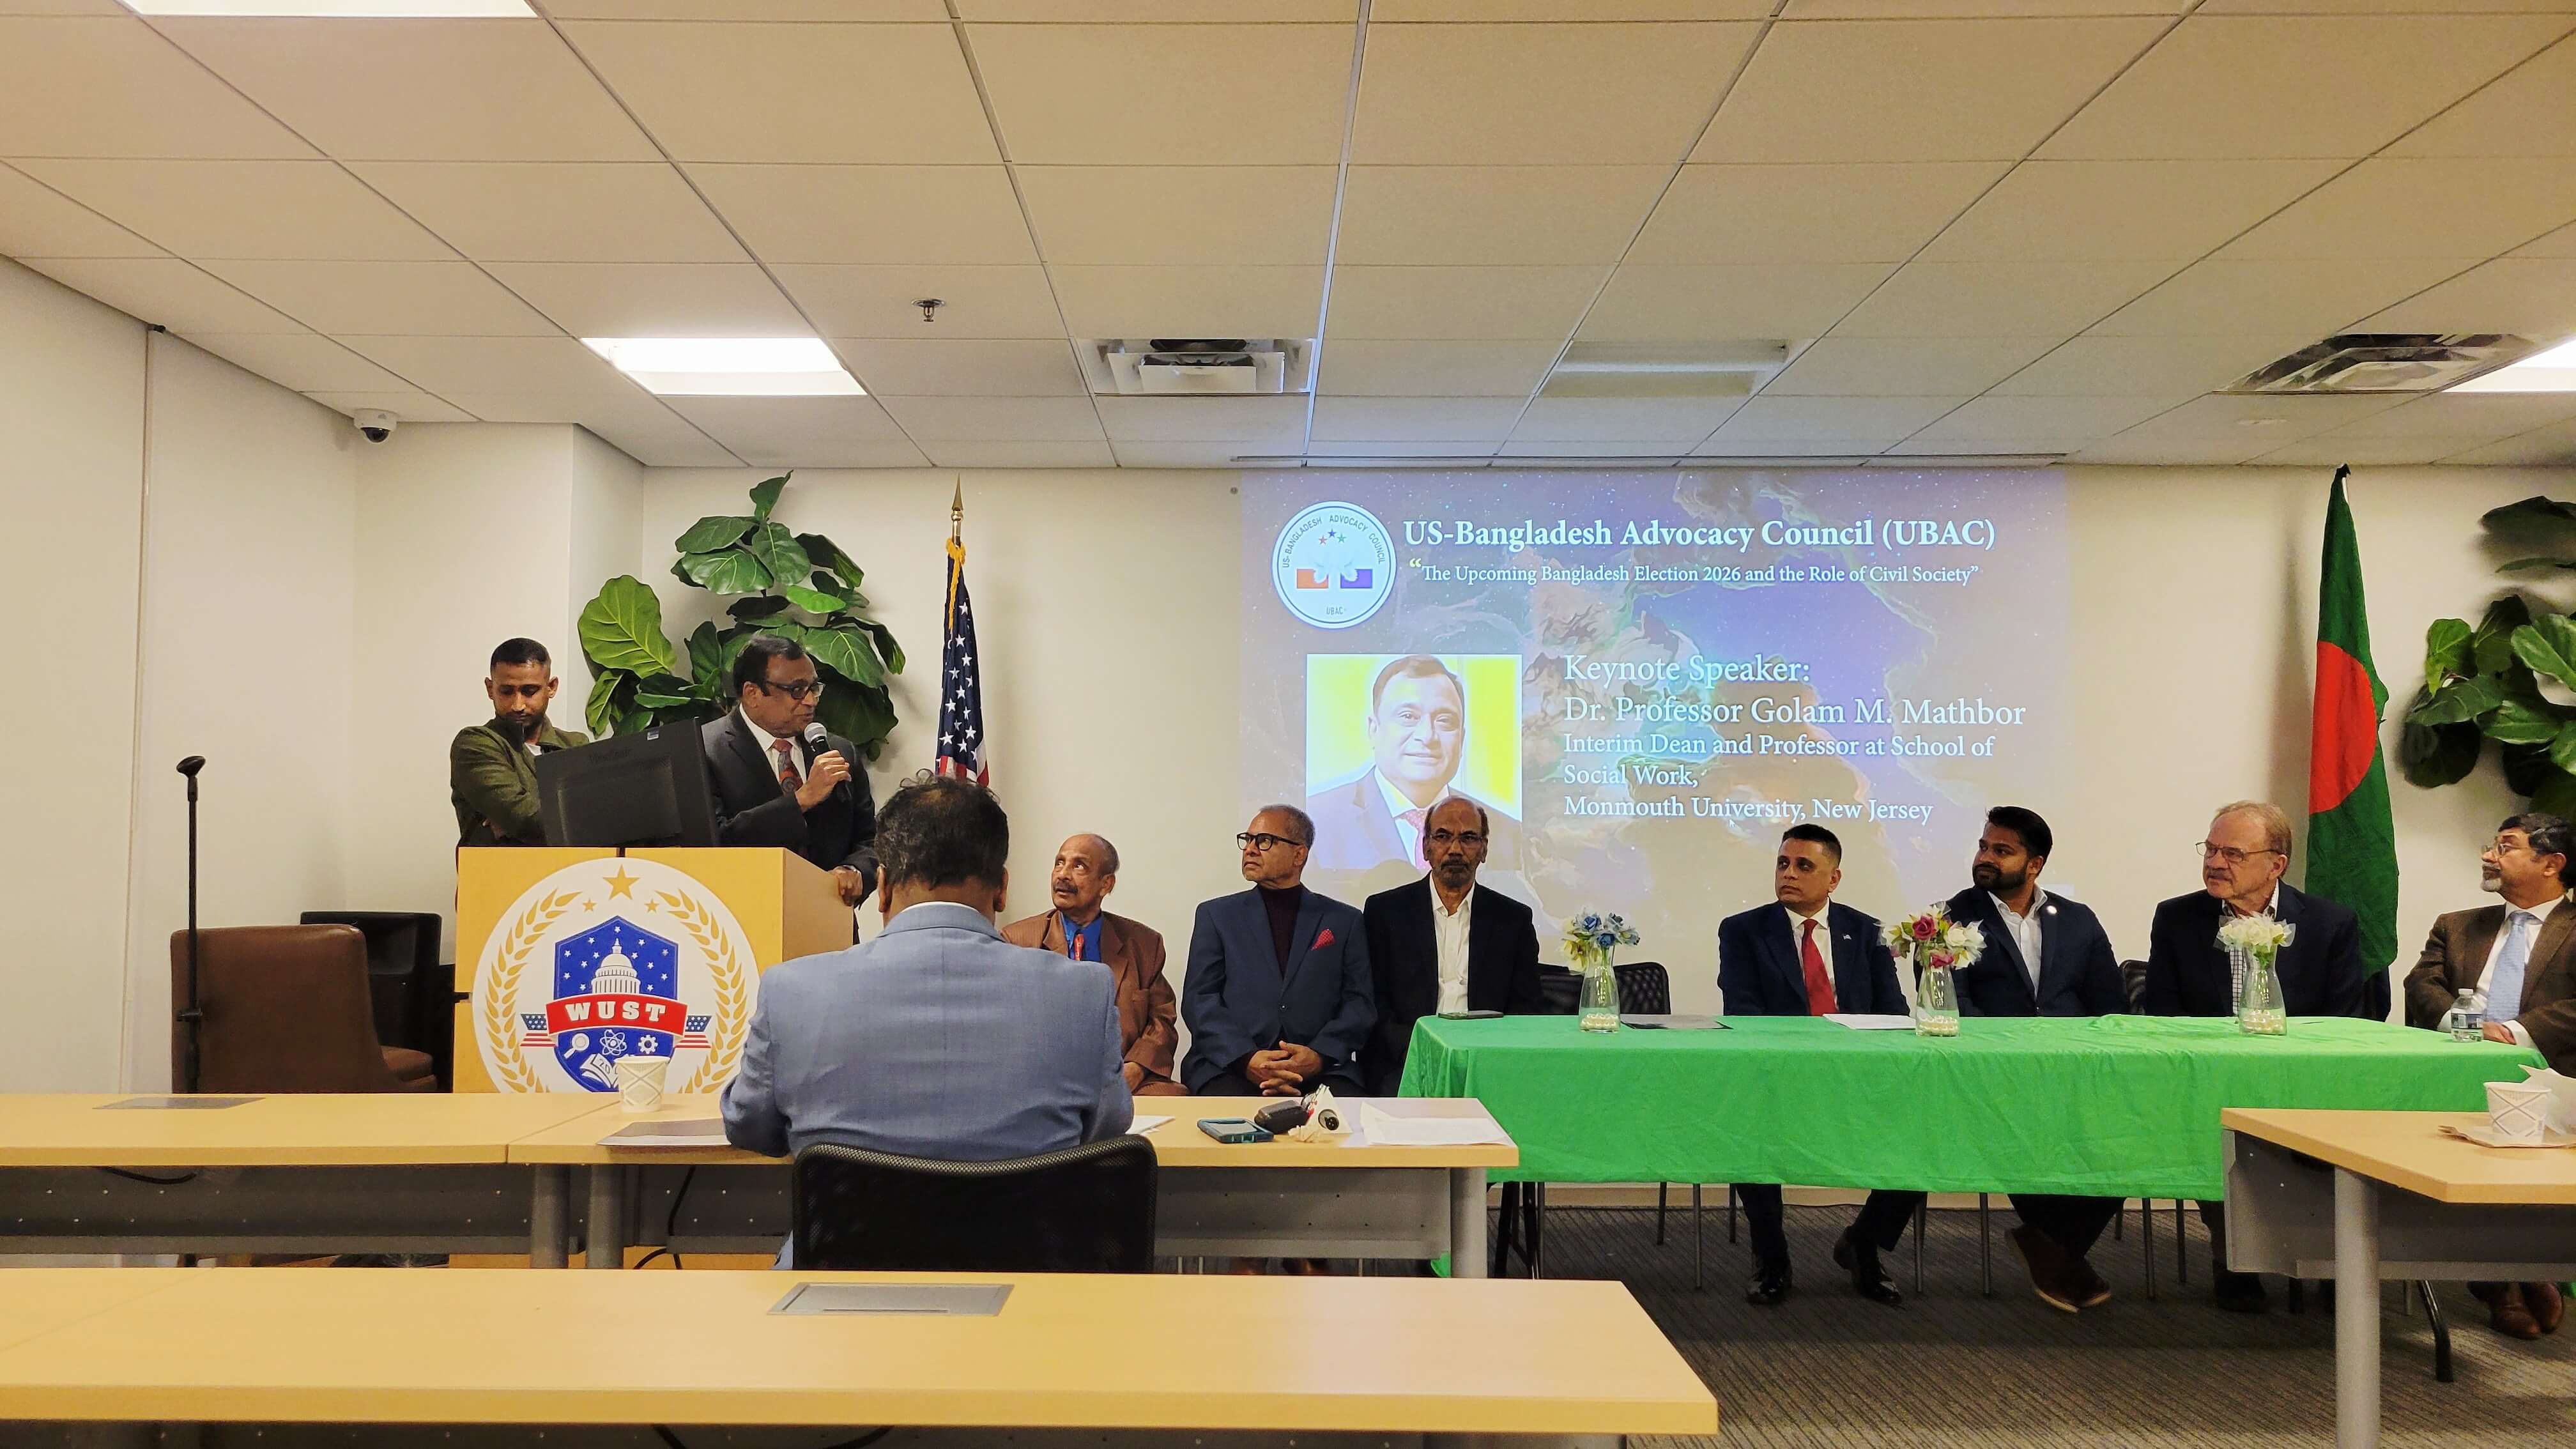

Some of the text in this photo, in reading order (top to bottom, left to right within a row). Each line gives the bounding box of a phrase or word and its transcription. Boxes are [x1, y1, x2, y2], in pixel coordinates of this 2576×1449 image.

[1330, 514, 1369, 532] ADVOCACY
[1368, 533, 1386, 564] COUNCIL
[1403, 519, 1995, 553] US-Bangladesh Advocacy Council (UBAC)
[1454, 565, 1538, 586] Upcoming
[1541, 565, 1630, 586] Bangladesh
[1634, 565, 1699, 582] Election
[1703, 566, 1742, 582] 2026
[1745, 565, 1776, 582] and
[1779, 565, 1805, 582] the
[1809, 565, 1845, 582] Role
[1849, 565, 1867, 582] of
[1869, 565, 1908, 582] Civil
[1326, 606, 1344, 615] UBAC
[1564, 654, 1810, 689] Keynote Speaker:
[1564, 695, 2027, 725] Dr. Professor Golam M. Mathbor
[1564, 733, 1997, 756] Interim Dean and Professor at School of
[1564, 764, 1699, 788] Social Work,
[1564, 796, 1934, 826] Monmouth University, New Jersey
[565, 1000, 666, 1022] WUST
